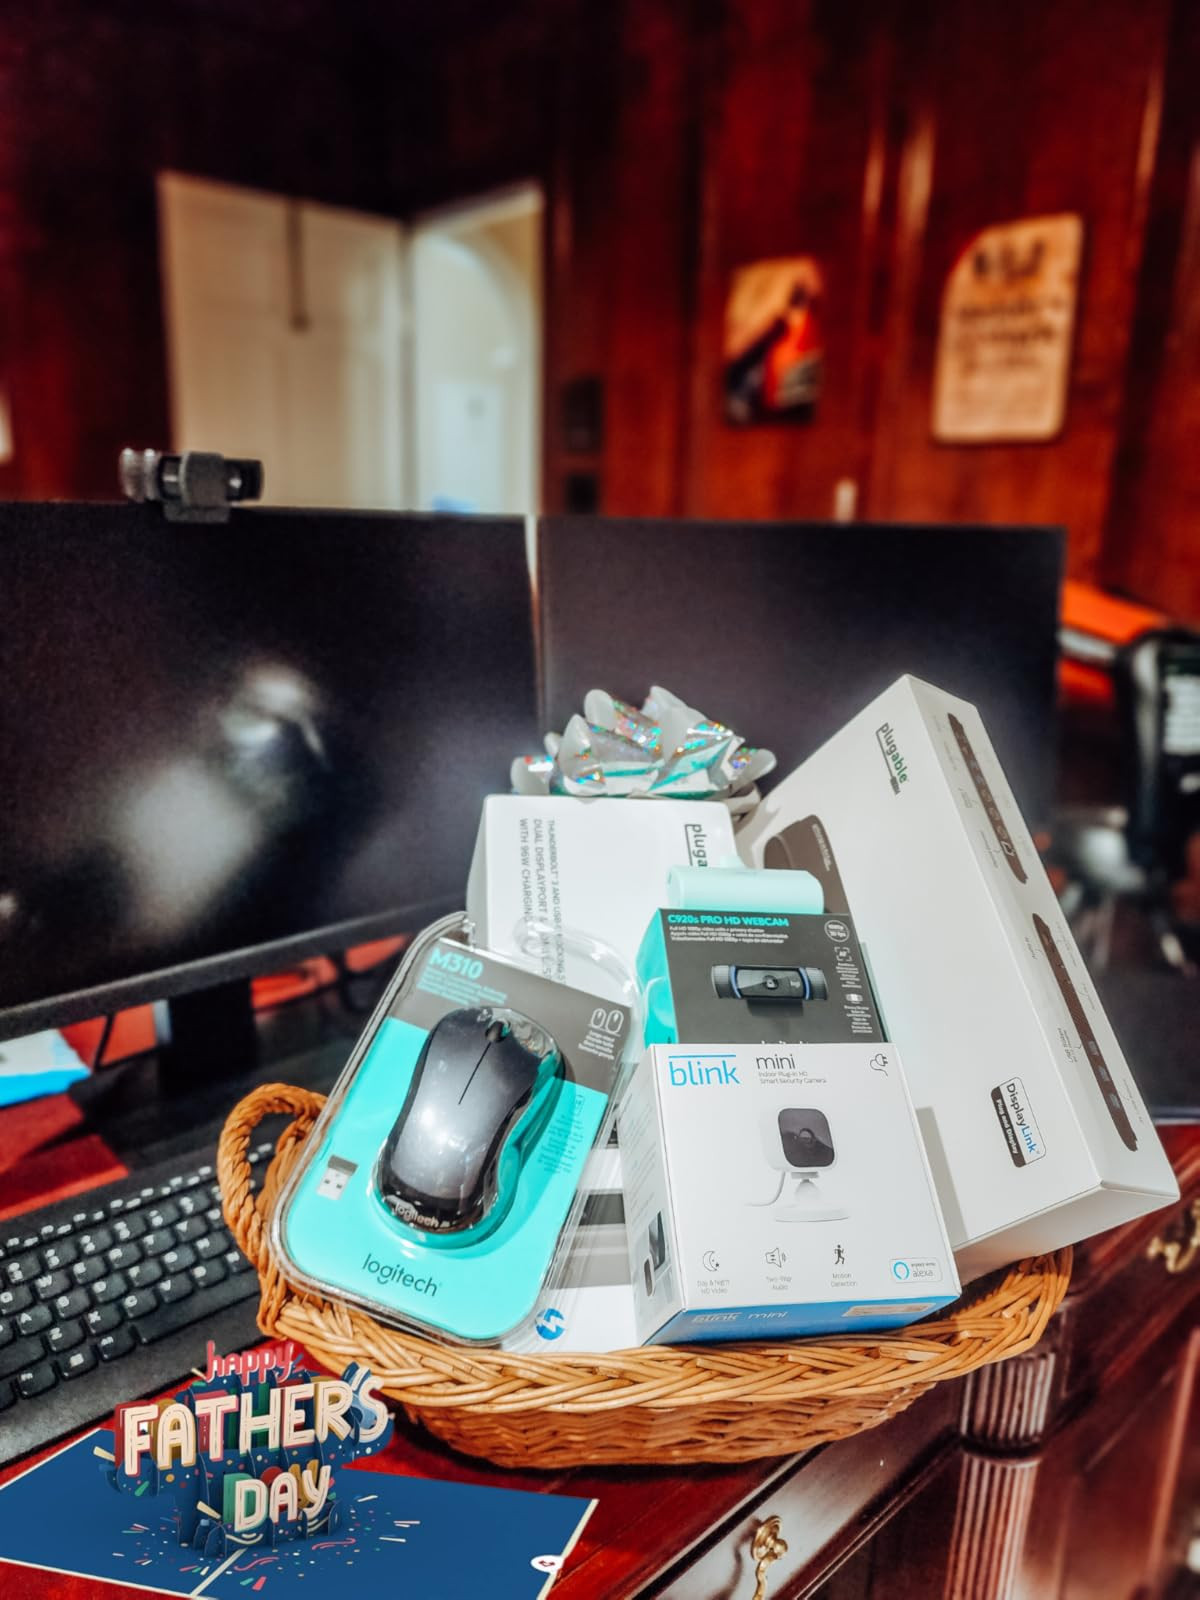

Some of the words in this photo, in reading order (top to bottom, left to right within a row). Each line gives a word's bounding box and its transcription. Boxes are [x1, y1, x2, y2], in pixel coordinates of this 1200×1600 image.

[879, 722, 909, 784] plugable
[519, 819, 529, 843] WITH
[534, 819, 544, 843] DUAL
[690, 823, 708, 868] pluga
[535, 847, 548, 912] DISPLAYPORT
[700, 915, 723, 925] PRO
[724, 915, 741, 926] HD
[741, 916, 789, 927] WEBCAM
[429, 947, 484, 980] M310
[668, 1060, 741, 1087] blink
[756, 1053, 796, 1070] mini
[1006, 1083, 1038, 1153] DisplayLink
[394, 1202, 440, 1228] logitech
[362, 1253, 438, 1297] logitech
[748, 1311, 788, 1320] mini
